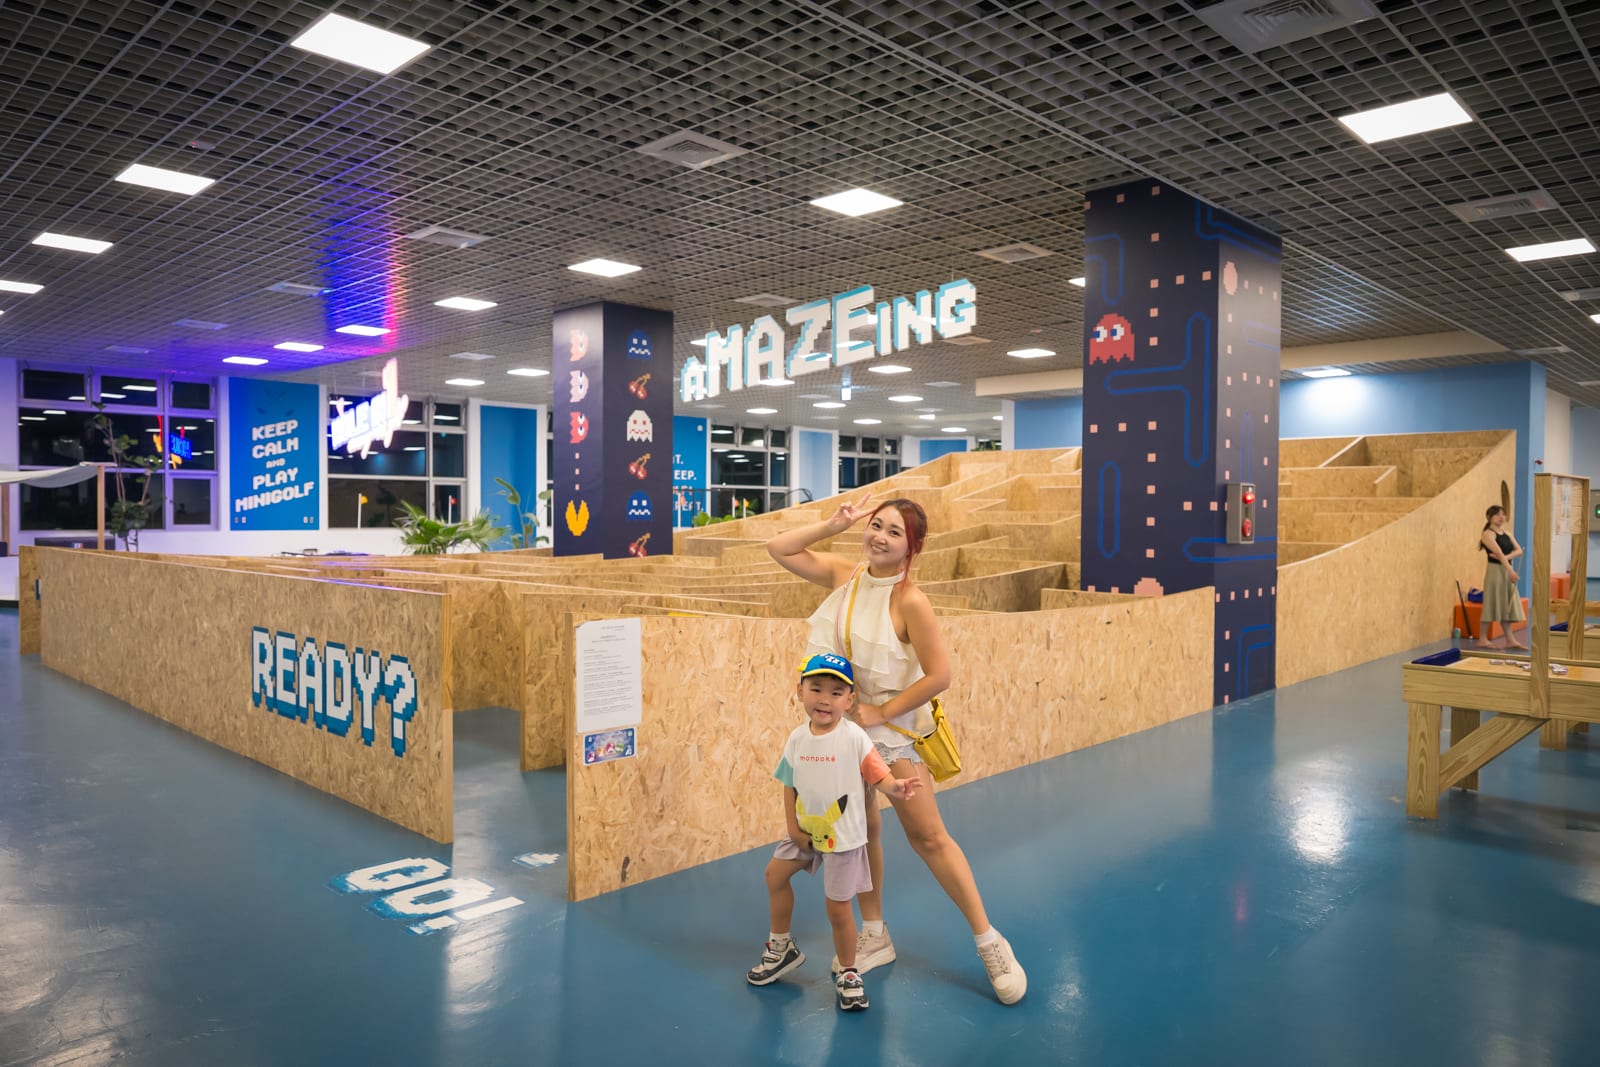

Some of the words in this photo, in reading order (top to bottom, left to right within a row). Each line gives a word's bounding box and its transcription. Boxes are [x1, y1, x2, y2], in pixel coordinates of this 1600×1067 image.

[252, 420, 298, 441] KEEP
[252, 437, 299, 459] CALM
[252, 467, 298, 490] PLAY
[673, 469, 697, 480] EEP.
[235, 481, 315, 513] MINIGOLF
[252, 626, 418, 758] READY?
[327, 857, 525, 935] GO!
